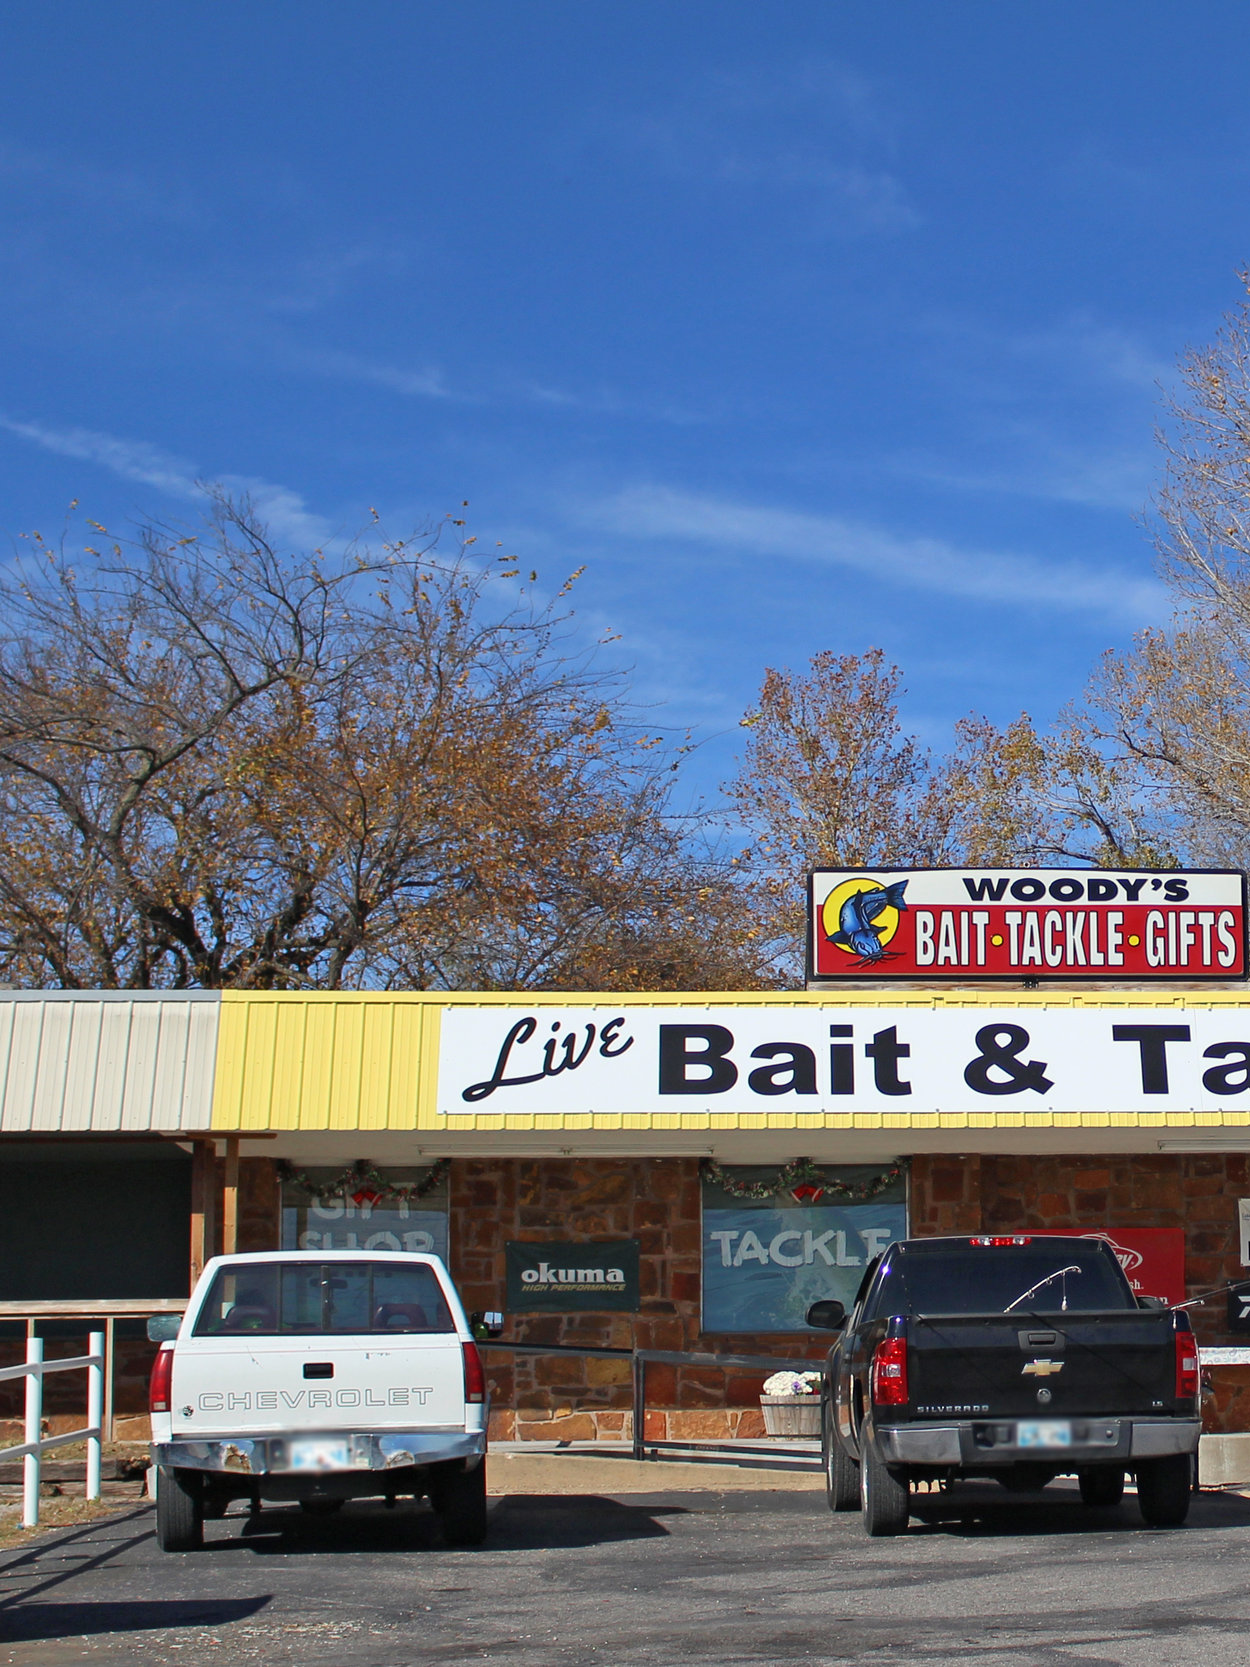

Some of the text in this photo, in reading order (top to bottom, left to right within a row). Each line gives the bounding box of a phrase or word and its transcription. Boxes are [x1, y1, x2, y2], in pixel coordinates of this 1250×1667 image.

[963, 877, 1190, 902] WOODY'S
[915, 908, 1237, 969] BAIT TACKLE GIFTS
[461, 1016, 634, 1103] Live
[658, 1023, 912, 1096] Bait
[963, 1022, 1055, 1096] &
[521, 1262, 626, 1283] okuma
[551, 1284, 626, 1292] PERFORMANCE
[199, 1387, 434, 1411] CHEVROLET
[917, 1405, 990, 1413] SILVERADO
